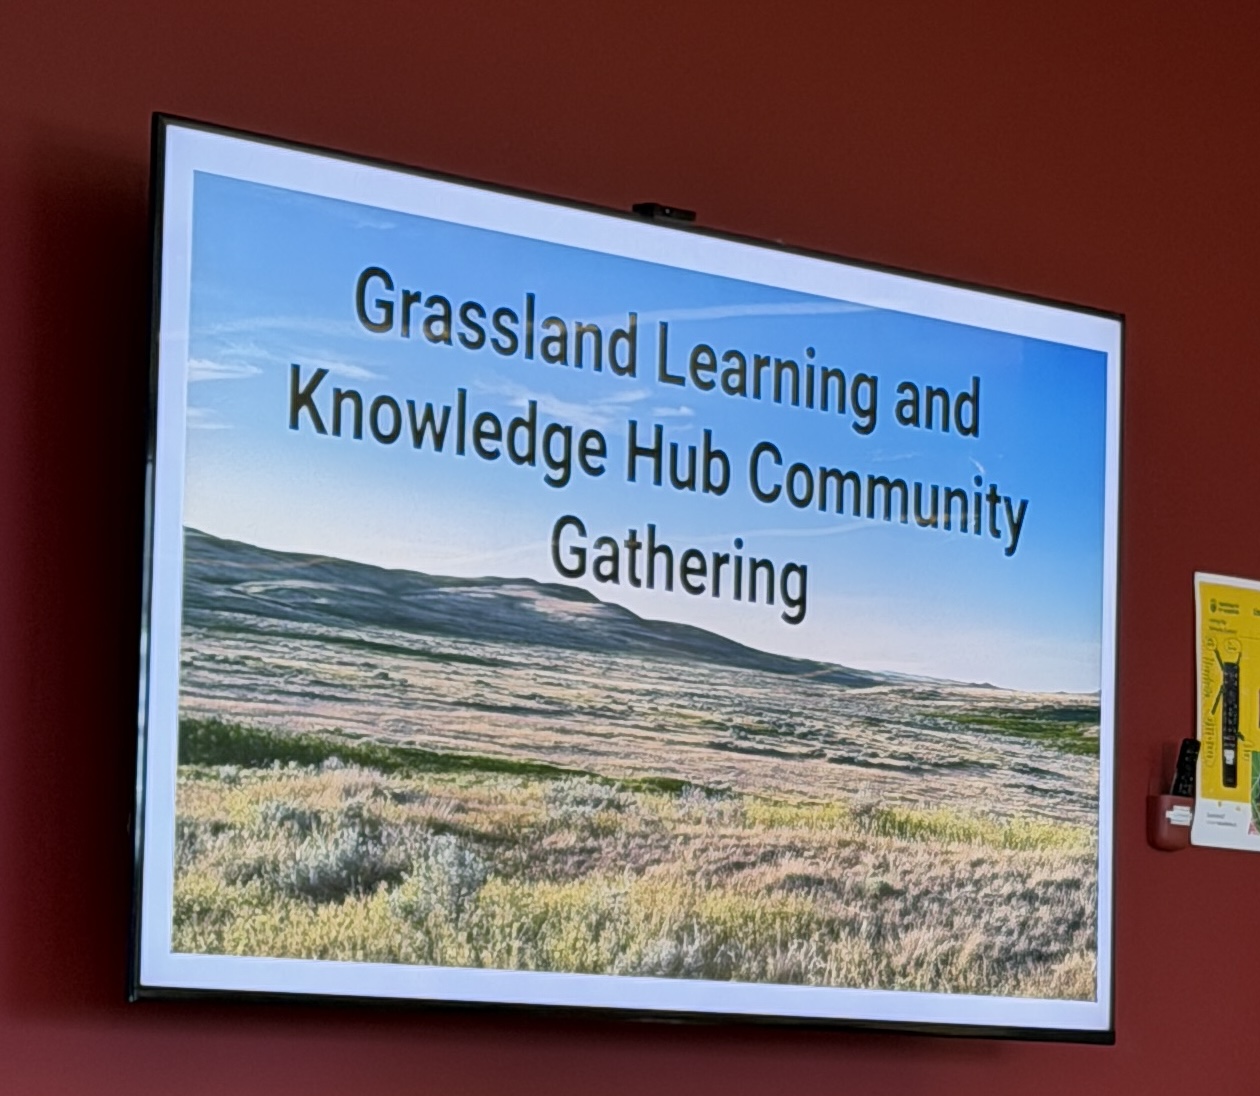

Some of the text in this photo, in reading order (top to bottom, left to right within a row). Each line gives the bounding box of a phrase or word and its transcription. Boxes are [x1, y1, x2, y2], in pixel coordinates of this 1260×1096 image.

[354, 265, 982, 438] Grassland Learning and
[289, 363, 1030, 558] Knowledge Hub Community
[552, 514, 809, 625] Gathering
